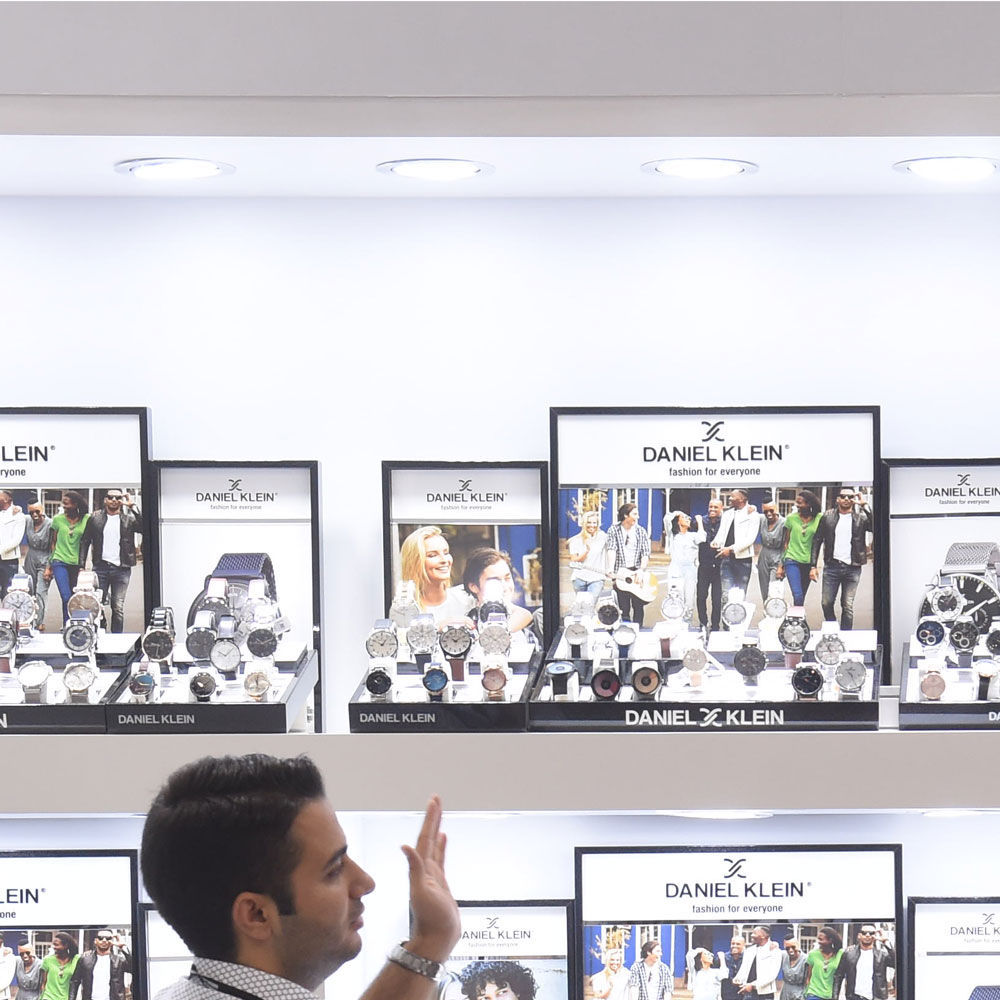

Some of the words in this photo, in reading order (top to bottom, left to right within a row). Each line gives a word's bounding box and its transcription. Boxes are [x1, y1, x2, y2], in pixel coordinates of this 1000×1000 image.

[1, 445, 49, 462] LEIN
[642, 445, 718, 462] DANIEL
[722, 444, 783, 462] KLEIN
[668, 466, 703, 477] fashion
[704, 466, 718, 476] for
[719, 467, 761, 478] everyone
[196, 492, 238, 502] DANIEL
[240, 492, 274, 502] KLEIN
[426, 492, 468, 503] DANIEL
[470, 492, 504, 502] KLEIN
[924, 487, 967, 497] DANIEL
[118, 714, 159, 725] DANIEL
[161, 714, 195, 725] KLEIN
[359, 712, 400, 723] DANIEL
[402, 713, 436, 723] KLEIN
[625, 710, 697, 725] DANIEL
[726, 710, 784, 725] KLEIN
[665, 882, 739, 899] DANIEL
[744, 881, 804, 898] KLEIN
[0, 888, 39, 904] EIN
[692, 903, 725, 914] fashion
[727, 903, 740, 913] for
[742, 904, 784, 915] everyone
[460, 930, 495, 940] ANIEL
[498, 930, 531, 940] KLEIN
[950, 926, 991, 936] DANIEL
